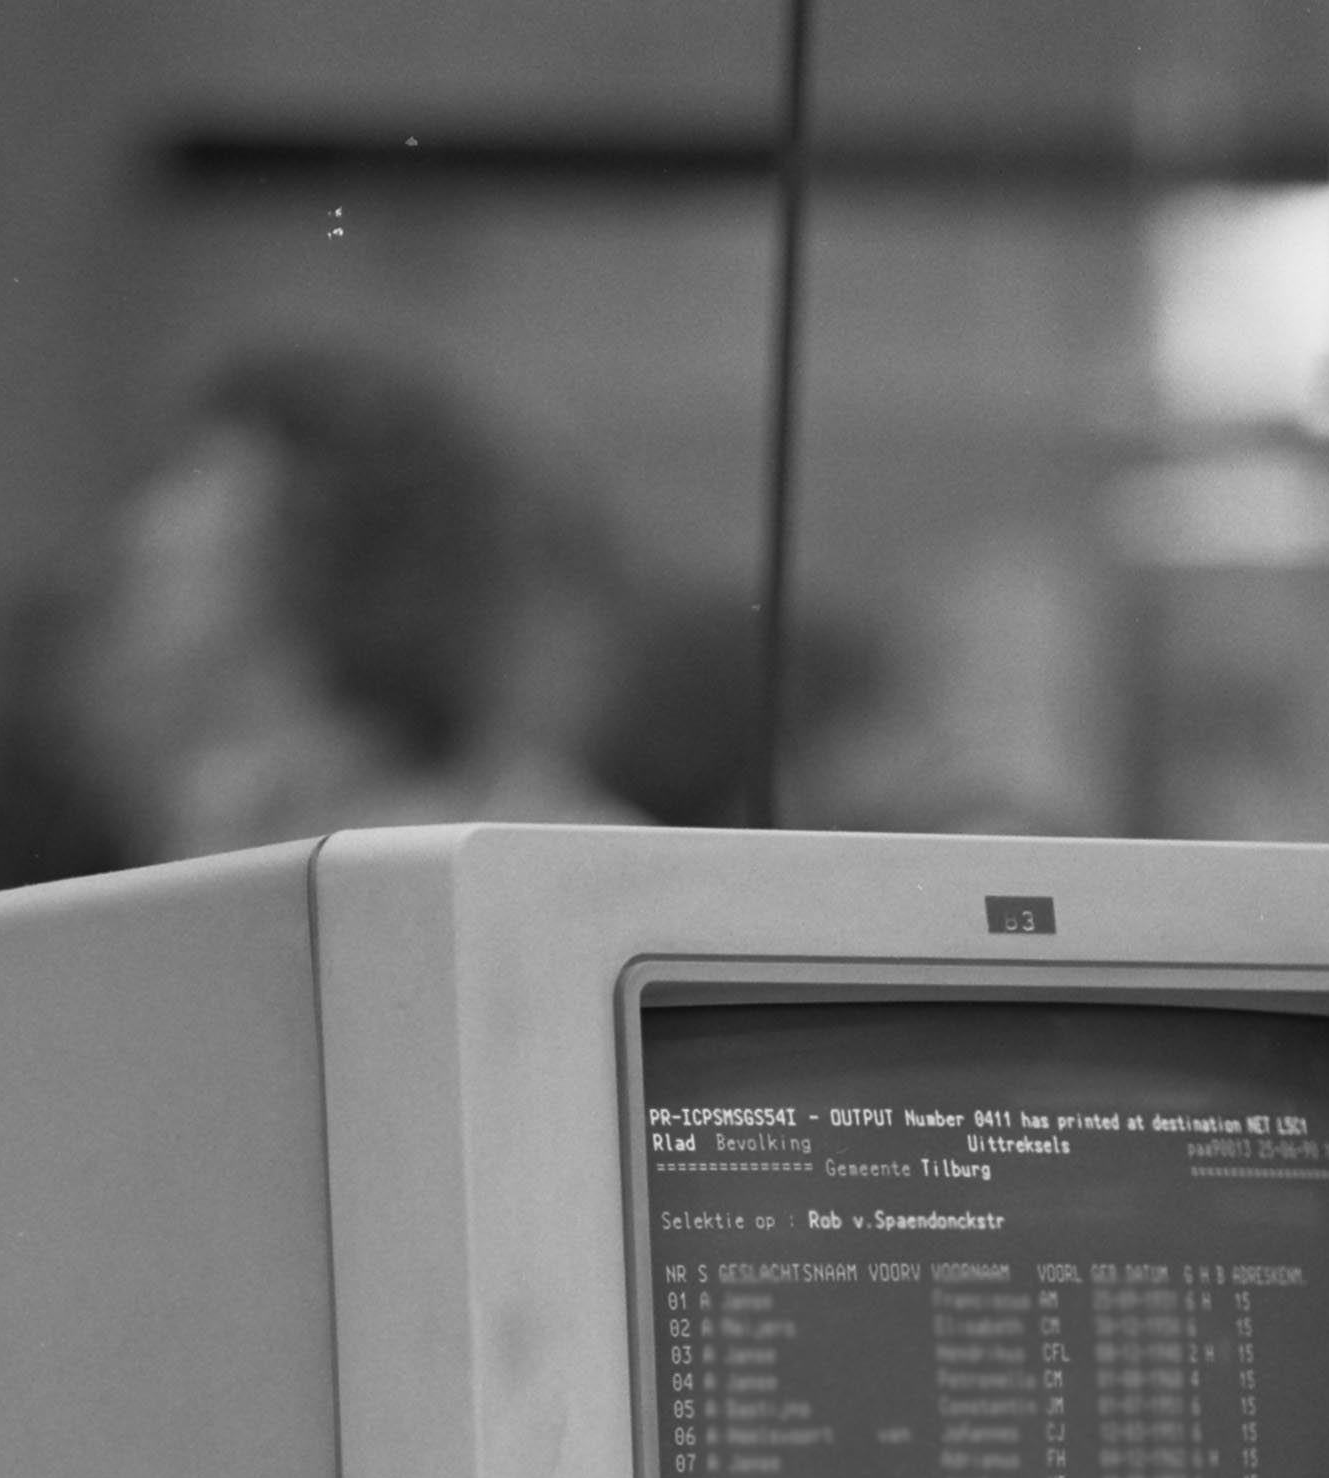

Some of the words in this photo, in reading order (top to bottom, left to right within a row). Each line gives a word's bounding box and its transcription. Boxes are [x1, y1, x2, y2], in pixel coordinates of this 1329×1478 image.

[830, 1108, 892, 1126] OUTPUT
[974, 1110, 1011, 1127] 0411
[1021, 1112, 1049, 1128] has
[1057, 1113, 1119, 1130] printed
[1127, 1115, 1144, 1130] at
[1152, 1114, 1241, 1133] destination
[717, 1133, 812, 1153] Bevolking
[967, 1134, 1070, 1154] Uittreksels
[826, 1158, 911, 1177] Gemeente
[921, 1158, 991, 1180] Tilburg
[662, 1211, 745, 1229] Selektie
[756, 1216, 775, 1231] op
[808, 1210, 842, 1229] Rob
[666, 1265, 687, 1283] NR
[719, 1263, 858, 1283] GESLACHTSNAAM
[869, 1263, 920, 1282] VOORV
